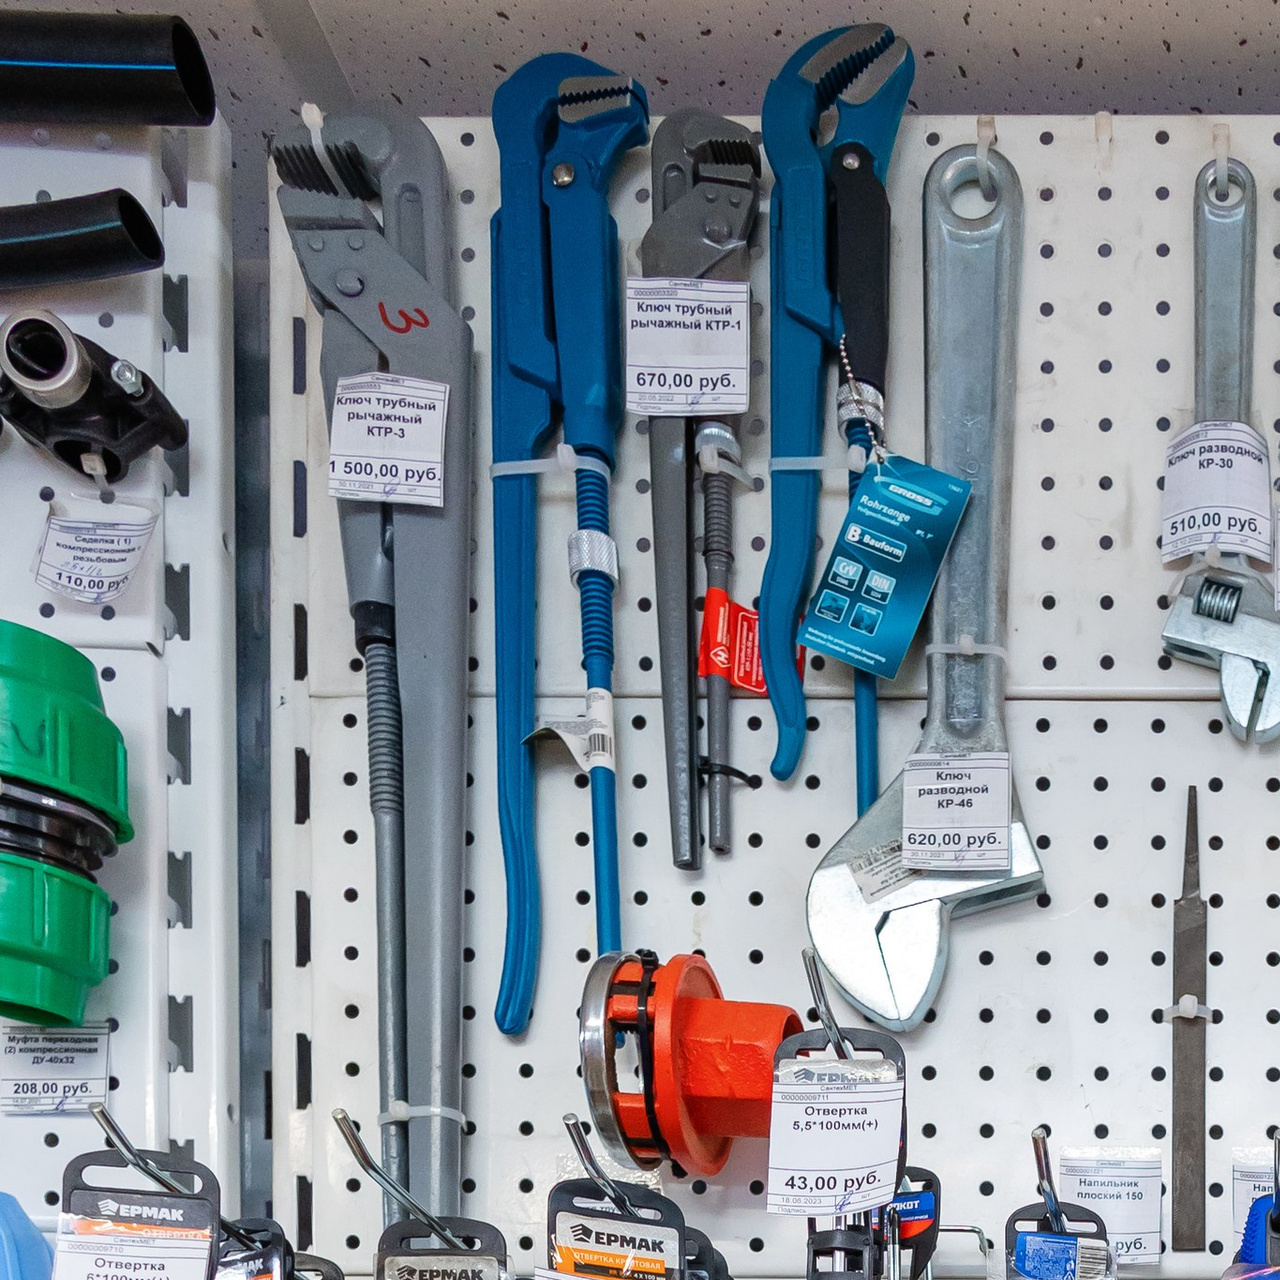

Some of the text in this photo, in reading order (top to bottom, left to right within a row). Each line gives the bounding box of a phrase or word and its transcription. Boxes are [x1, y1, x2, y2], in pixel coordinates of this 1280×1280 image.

[636, 302, 733, 318] Ключ трубный
[631, 319, 702, 333] рычажный
[636, 372, 737, 391] 670,00 руб.
[336, 395, 437, 412] Ключ трубный
[347, 410, 423, 426] рычажный
[367, 426, 406, 439] КТР-3
[1198, 457, 1234, 471] КР-30
[343, 461, 399, 479] 500,00
[405, 465, 441, 484] руб.
[860, 495, 910, 522] Rohrzange
[1170, 514, 1262, 537] 510,00 руб.
[918, 785, 989, 798] разводной
[937, 797, 973, 810] КР-46
[907, 831, 1002, 850] 620,00 руб.
[13, 1082, 93, 1098] 208,00 руб.
[804, 1105, 868, 1118] Отвертка
[784, 1173, 882, 1194] 43,00 руб.
[1079, 1178, 1139, 1190] Напильник
[118, 1203, 184, 1222] ЕРМАК
[594, 1230, 665, 1254] ЕРМАК
[94, 1258, 166, 1272] Отвертка
